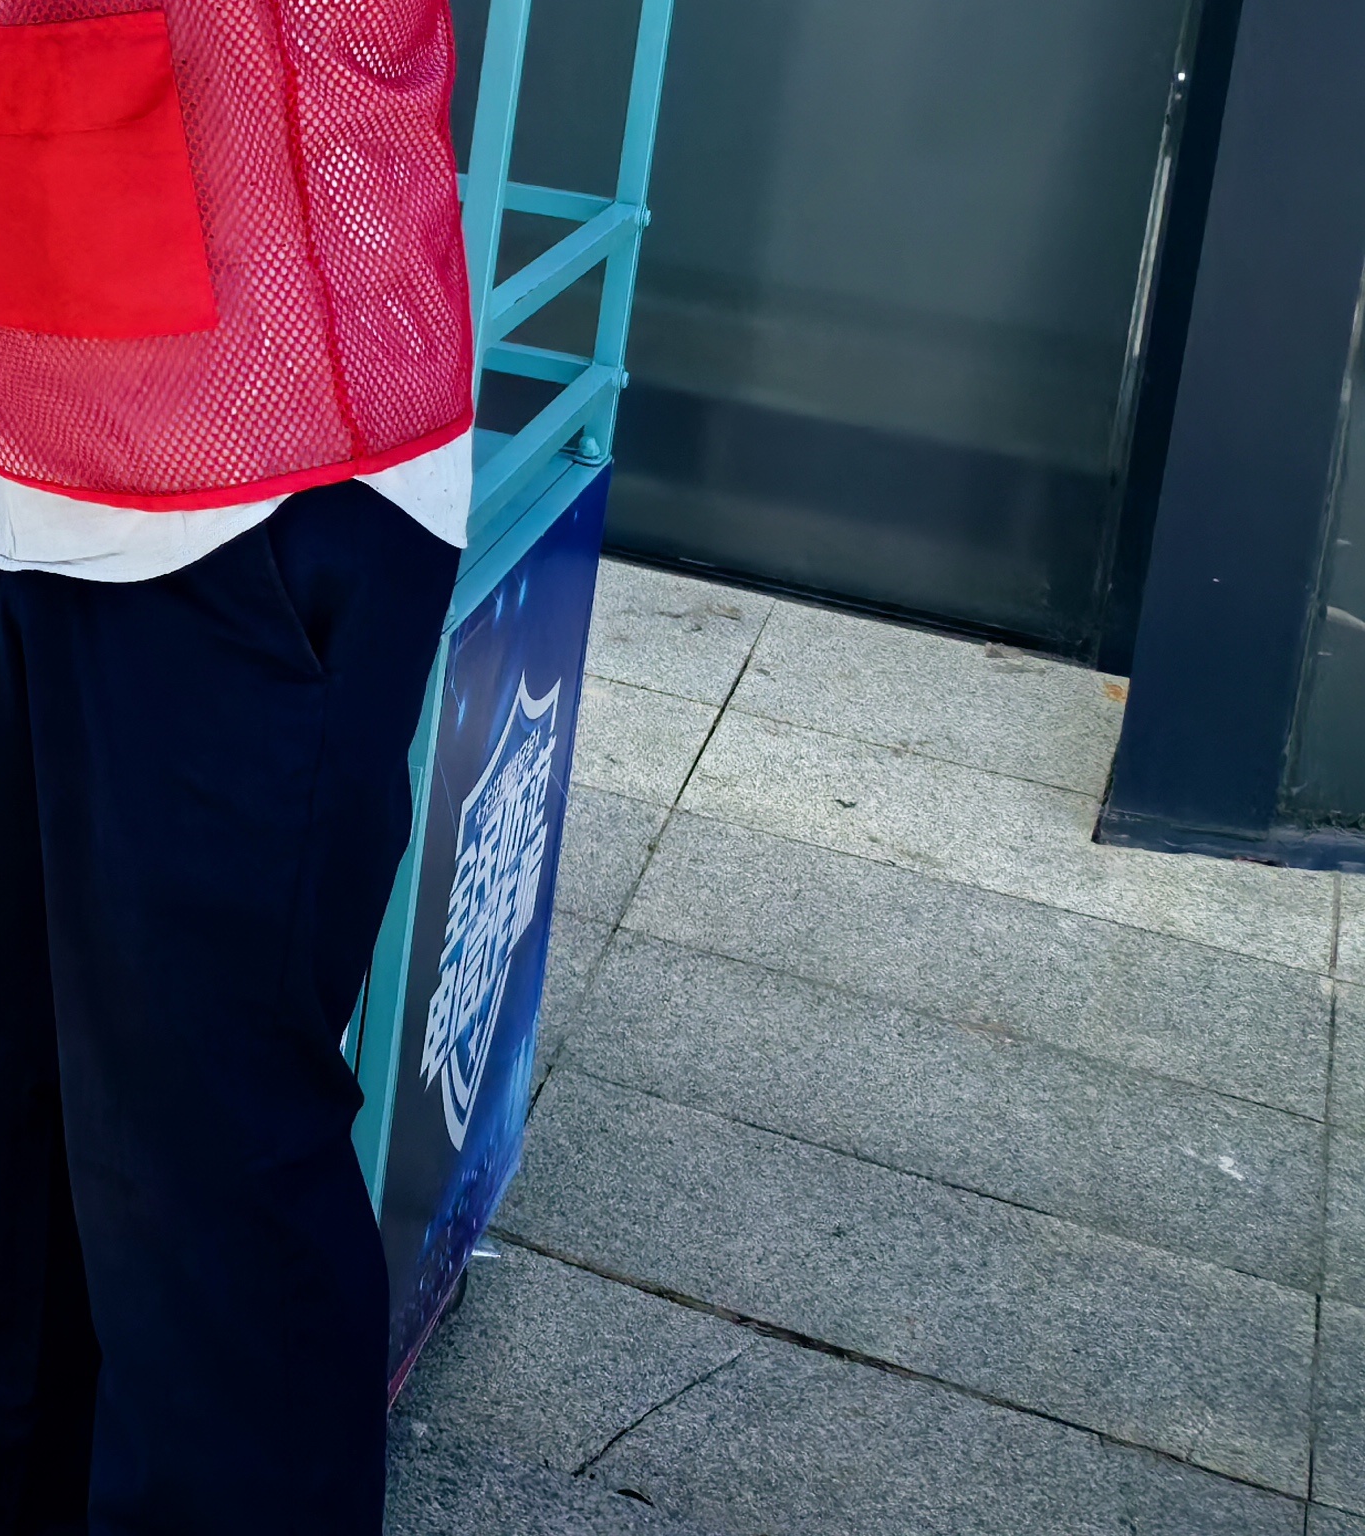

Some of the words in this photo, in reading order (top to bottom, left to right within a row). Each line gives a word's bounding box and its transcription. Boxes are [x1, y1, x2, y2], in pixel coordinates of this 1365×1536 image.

[419, 823, 547, 1089] 电信诈骗
[438, 735, 556, 971] 全民防范
